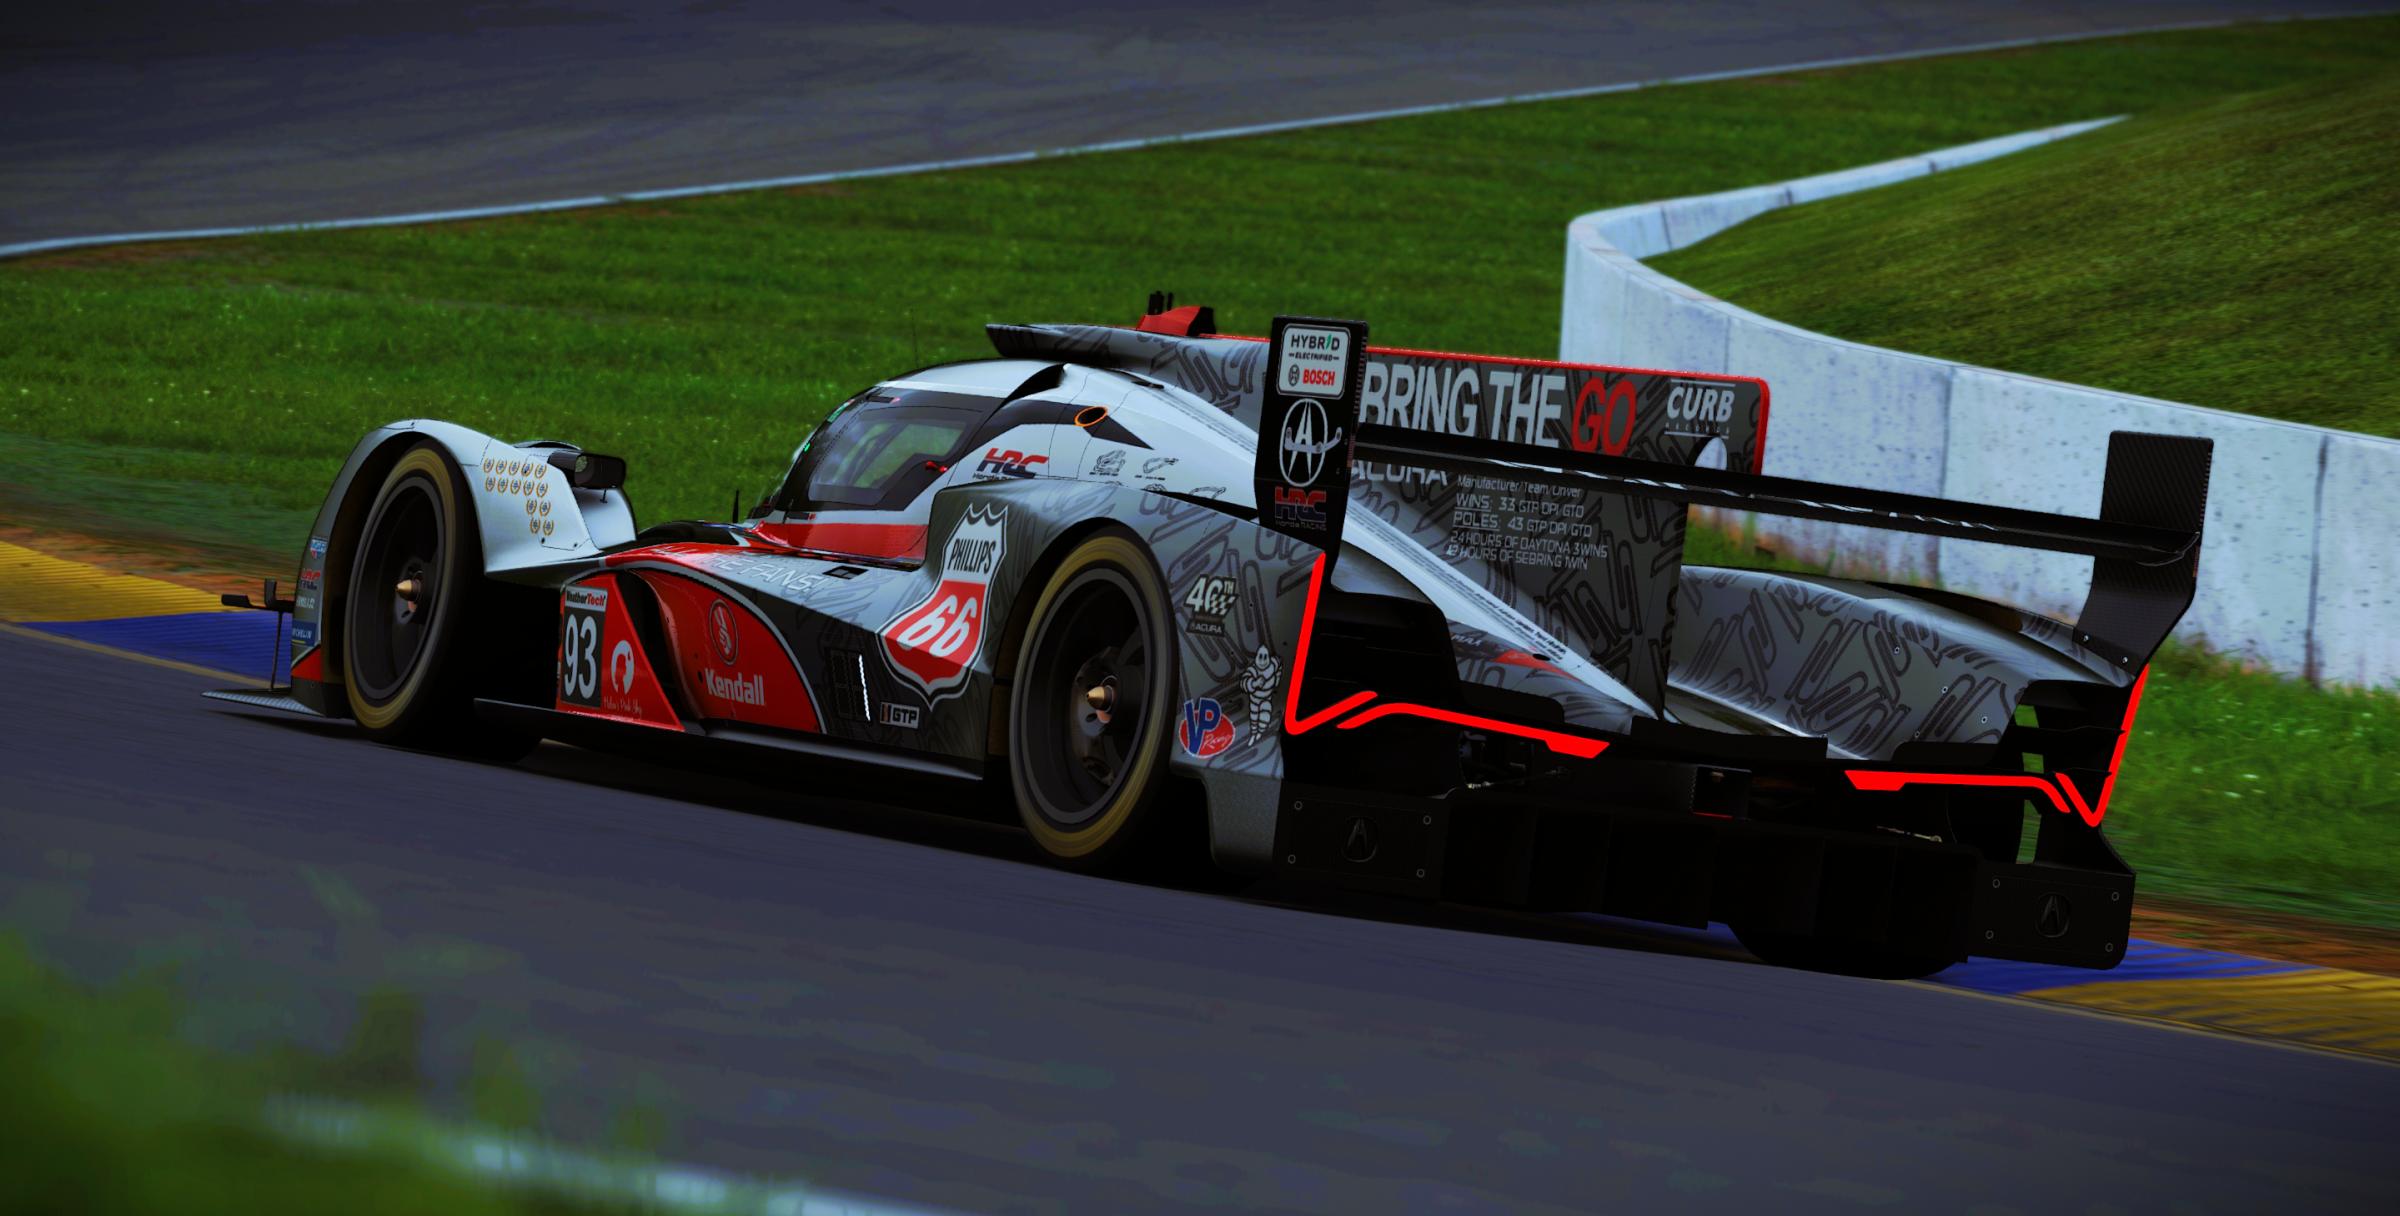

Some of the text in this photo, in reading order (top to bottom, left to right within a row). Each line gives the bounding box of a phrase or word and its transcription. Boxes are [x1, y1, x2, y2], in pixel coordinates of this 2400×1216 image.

[1290, 333, 1340, 350] HYBRID
[1295, 351, 1333, 361] ELECTRIFIED
[1302, 368, 1335, 386] BOSCH
[1358, 361, 1638, 456] BRING THE GO
[1667, 386, 1735, 423] CURB
[976, 447, 1050, 479] HRC
[1274, 485, 1327, 523] HRC
[1498, 496, 1516, 512] 33
[1519, 500, 1540, 514] GTP
[1507, 515, 1523, 531] 43
[1526, 519, 1549, 533] GTP
[947, 537, 997, 575] PHILLIPS
[1459, 546, 1497, 562] HOURS
[1498, 549, 1514, 563] OF
[1515, 551, 1563, 569] SEBRING
[1504, 535, 1519, 548] OF
[1520, 537, 1570, 555] DAYTONA
[738, 563, 829, 592] FANS!
[896, 594, 978, 658] 66
[564, 613, 598, 699] 93
[704, 667, 766, 706] Kendall
[892, 706, 918, 725] GTP
[1183, 697, 1223, 756] VP
